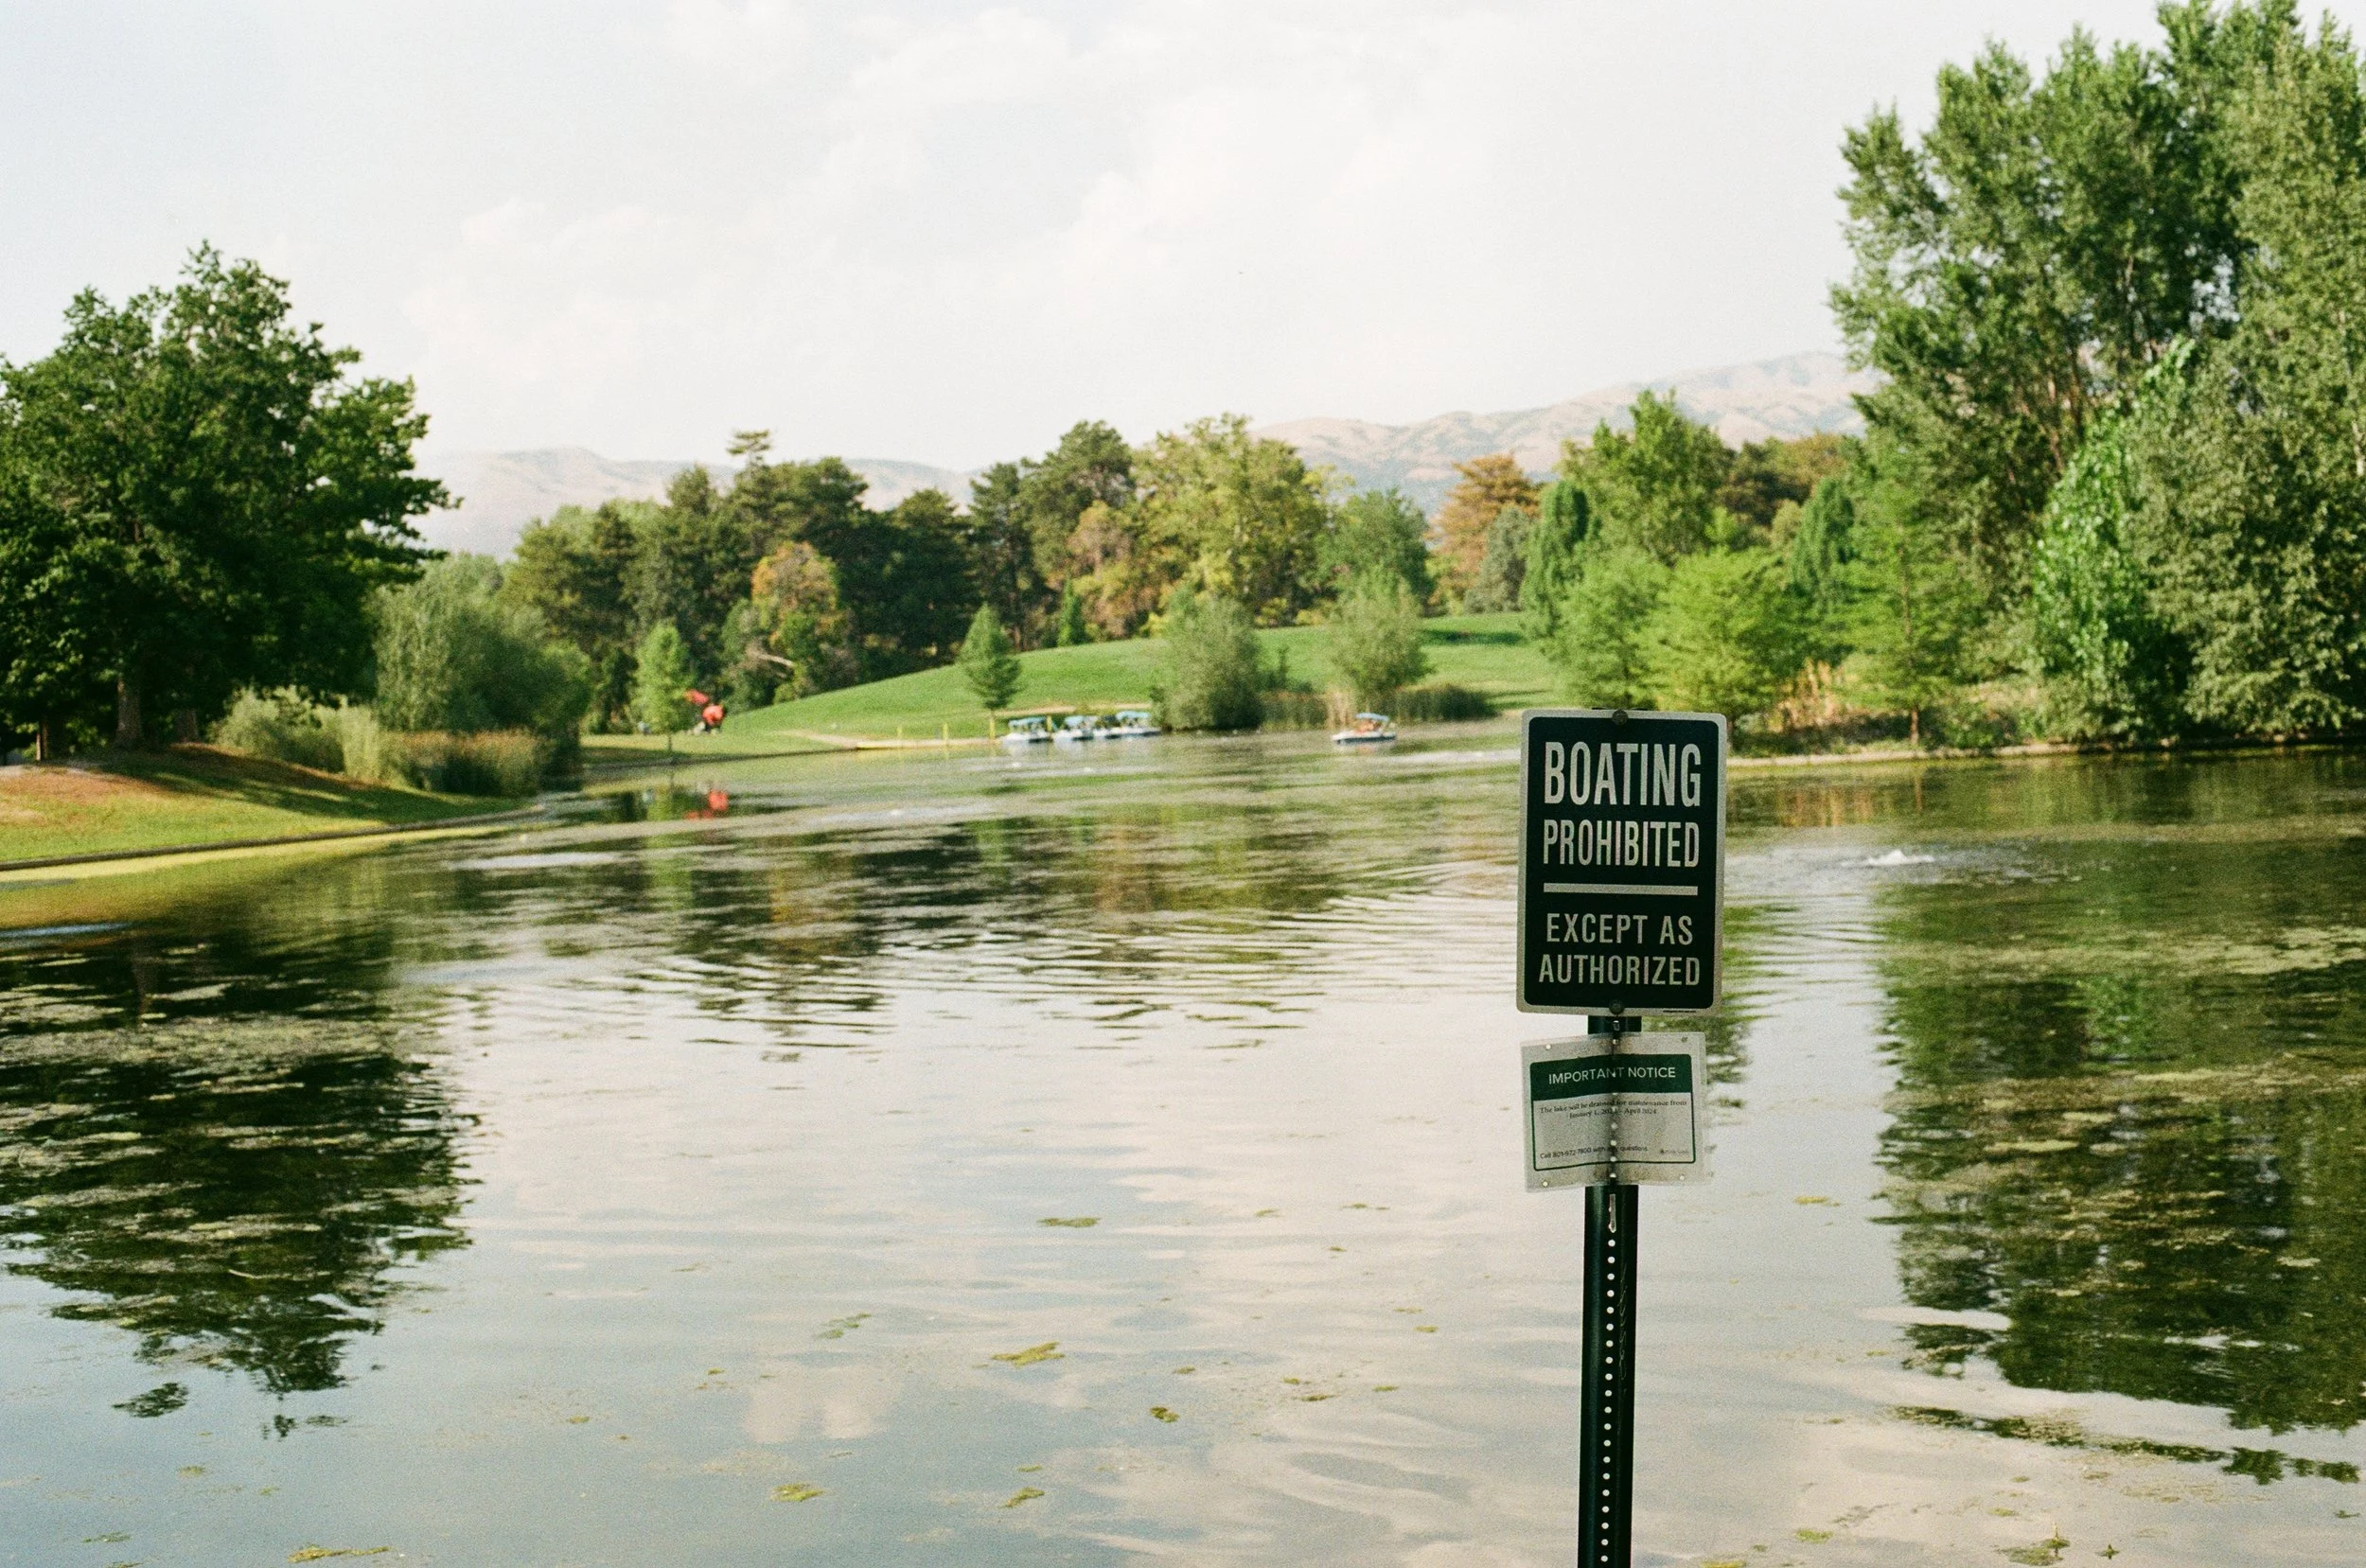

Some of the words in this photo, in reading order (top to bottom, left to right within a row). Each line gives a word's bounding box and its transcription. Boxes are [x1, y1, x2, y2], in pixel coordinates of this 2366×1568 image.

[1544, 741, 1702, 807] BOATING
[1543, 819, 1700, 868] PROHIBITED
[1546, 912, 1648, 944] EXCEPT
[1659, 915, 1693, 945] AS
[1539, 954, 1700, 986] AUTHORIZED
[1548, 1066, 1625, 1084] IMPORTANT
[1628, 1066, 1676, 1079] NOTICE
